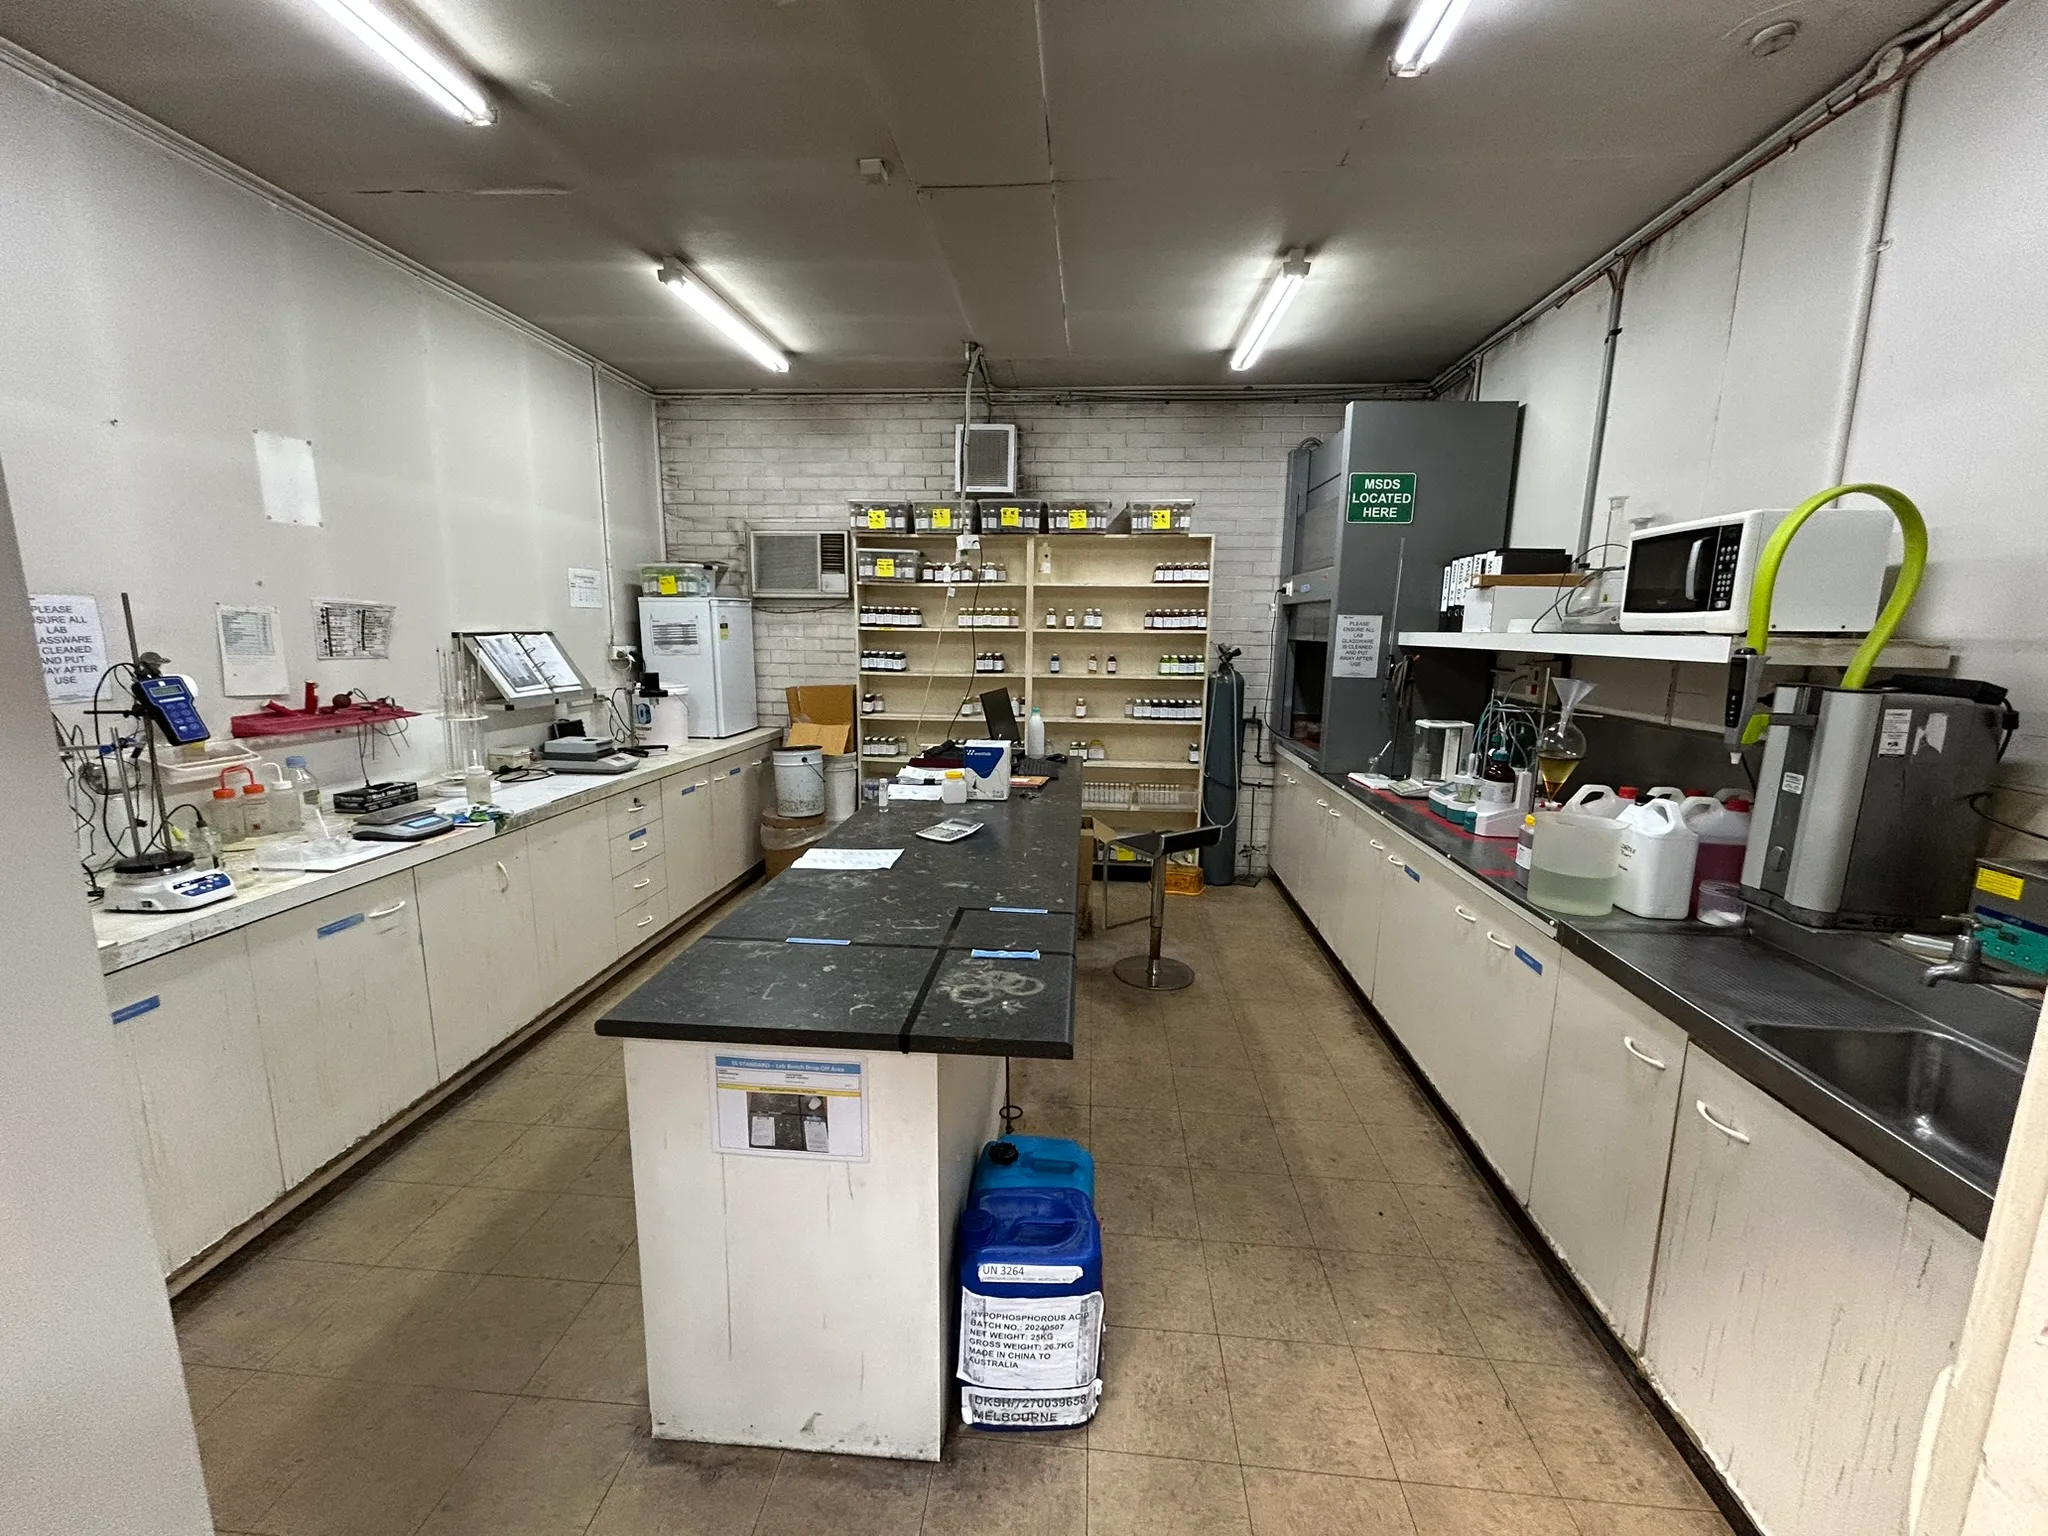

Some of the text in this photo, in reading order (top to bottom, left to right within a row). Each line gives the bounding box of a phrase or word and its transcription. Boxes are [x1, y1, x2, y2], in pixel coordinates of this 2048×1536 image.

[1364, 478, 1401, 490] MSDS
[1352, 492, 1411, 504] LOCATED
[1362, 506, 1398, 518] HERE
[31, 605, 73, 614] PLEASE
[35, 615, 88, 624] SURE ALL
[46, 626, 68, 634] LAB
[38, 635, 93, 645] ASSWARE
[41, 645, 93, 655] CLEANED
[65, 655, 86, 664] PUT
[64, 665, 99, 674] AFTER
[54, 676, 78, 685] USE
[739, 1060, 771, 1069] STANDARD
[787, 1063, 805, 1071] Bench
[805, 1064, 820, 1073] Drop
[831, 1065, 845, 1073] Area
[982, 1265, 1024, 1276] UN 3264
[971, 1311, 1090, 1322] HYPOPHOSPHOROUS ACID
[970, 1320, 1002, 1330] BATCH
[1025, 1323, 1065, 1331] 20240507
[969, 1328, 1054, 1341] NET WEIGHT: 25KG
[969, 1337, 1075, 1351] GROSS WEIGHT: 26.7KG
[969, 1346, 1051, 1360] MADE IN CHINA TO
[968, 1356, 1019, 1369] AUSTRALIA
[972, 1408, 1058, 1422] MELBOURNE
